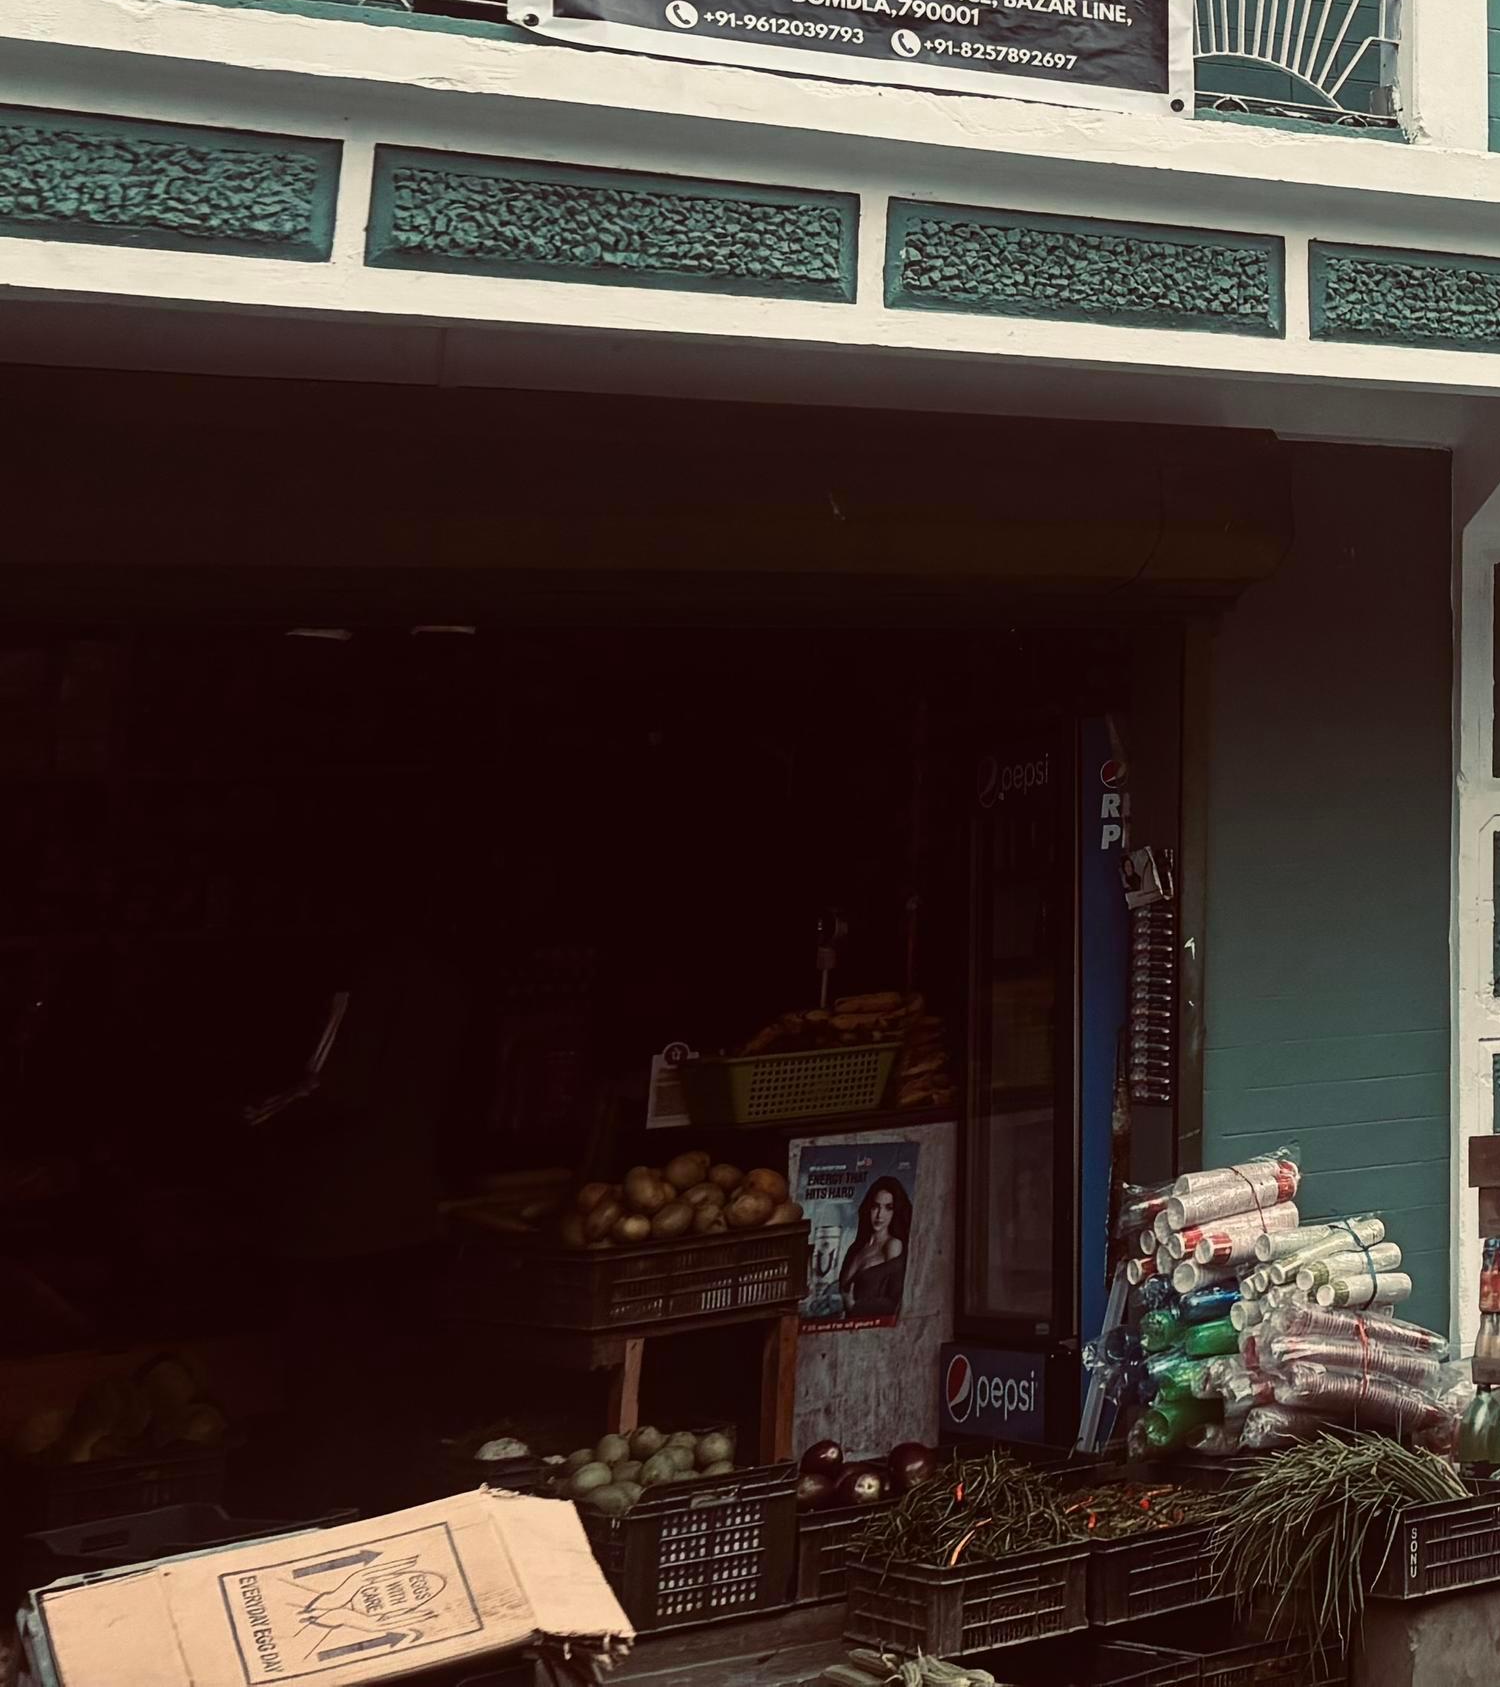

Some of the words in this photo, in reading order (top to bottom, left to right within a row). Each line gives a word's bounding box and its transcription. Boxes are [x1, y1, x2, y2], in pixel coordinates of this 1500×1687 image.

[703, 11, 865, 45] +91-9612039793
[1082, 1, 1133, 27] LINE,
[923, 40, 1078, 71] +91-8257892697
[1001, 752, 1049, 797] pepsi
[805, 1187, 828, 1201] HITS
[828, 1185, 855, 1200] HARD
[807, 1172, 845, 1187] ENERGY
[845, 1170, 868, 1184] THAT
[976, 1369, 1035, 1422] pepsi
[1409, 1527, 1418, 1579] SONU
[239, 1575, 269, 1627] EVERYDAY
[360, 1585, 385, 1614] CARE
[385, 1580, 408, 1607] WITH
[408, 1573, 431, 1602] EGGS
[253, 1627, 276, 1654] EGG
[261, 1652, 284, 1673] DAY
